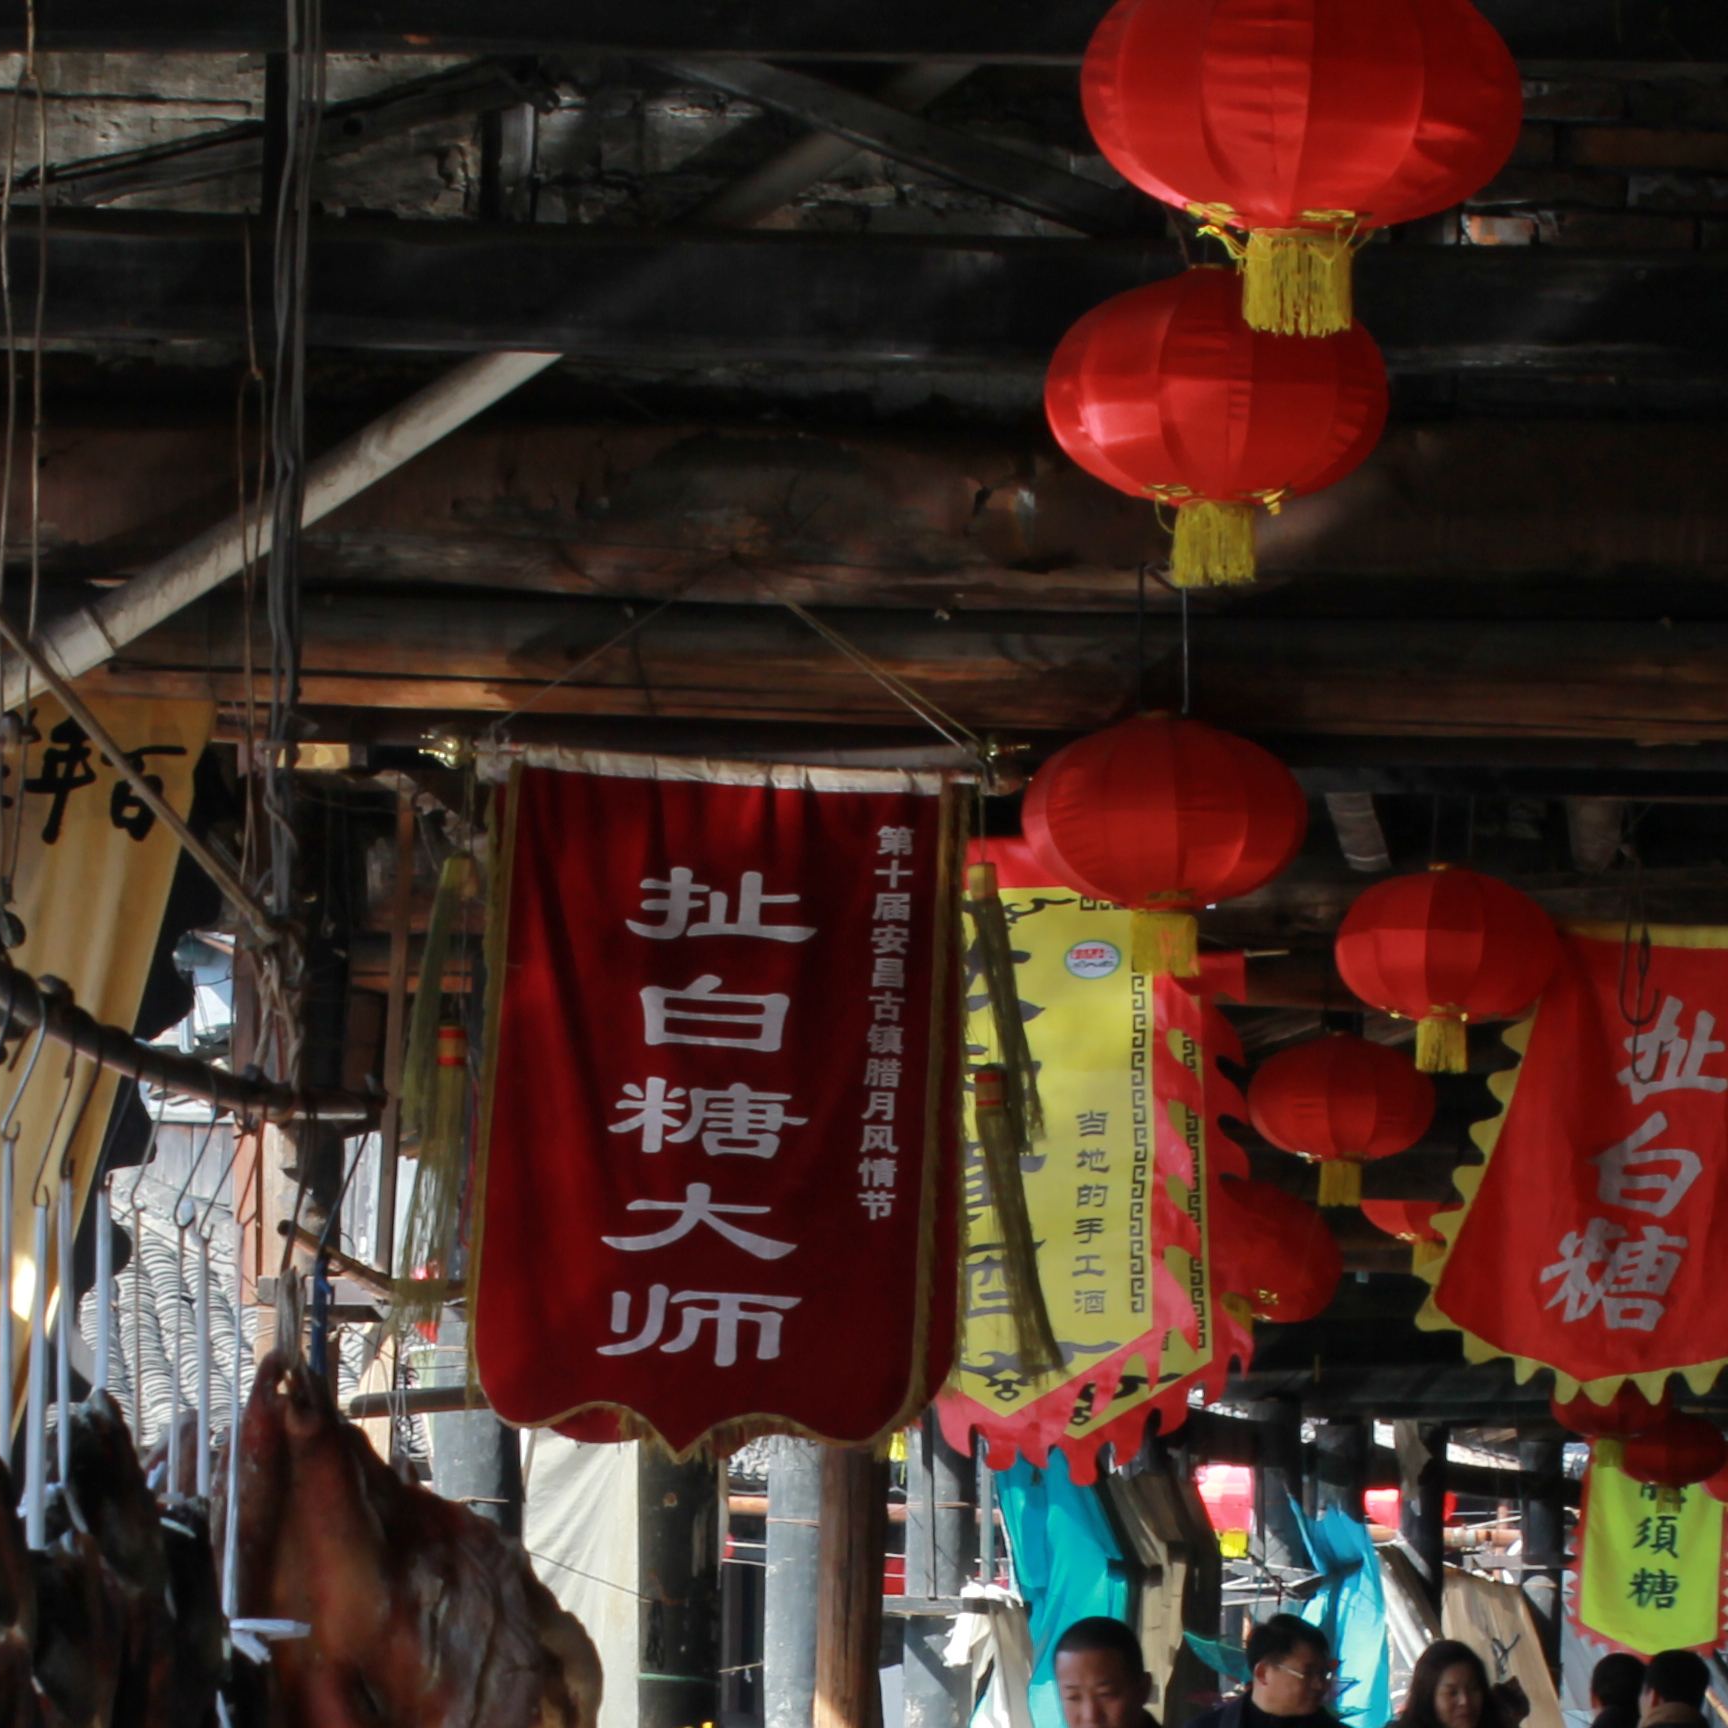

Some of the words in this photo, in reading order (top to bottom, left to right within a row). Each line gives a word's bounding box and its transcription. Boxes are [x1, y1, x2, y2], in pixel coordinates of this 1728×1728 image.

[596, 866, 818, 1368] 扯白糖大师
[858, 825, 915, 1220] 第十届安昌古镇腊月风情节
[1539, 996, 1728, 1332] 扯白糖
[1071, 1108, 1110, 1316] 当地的手工酒
